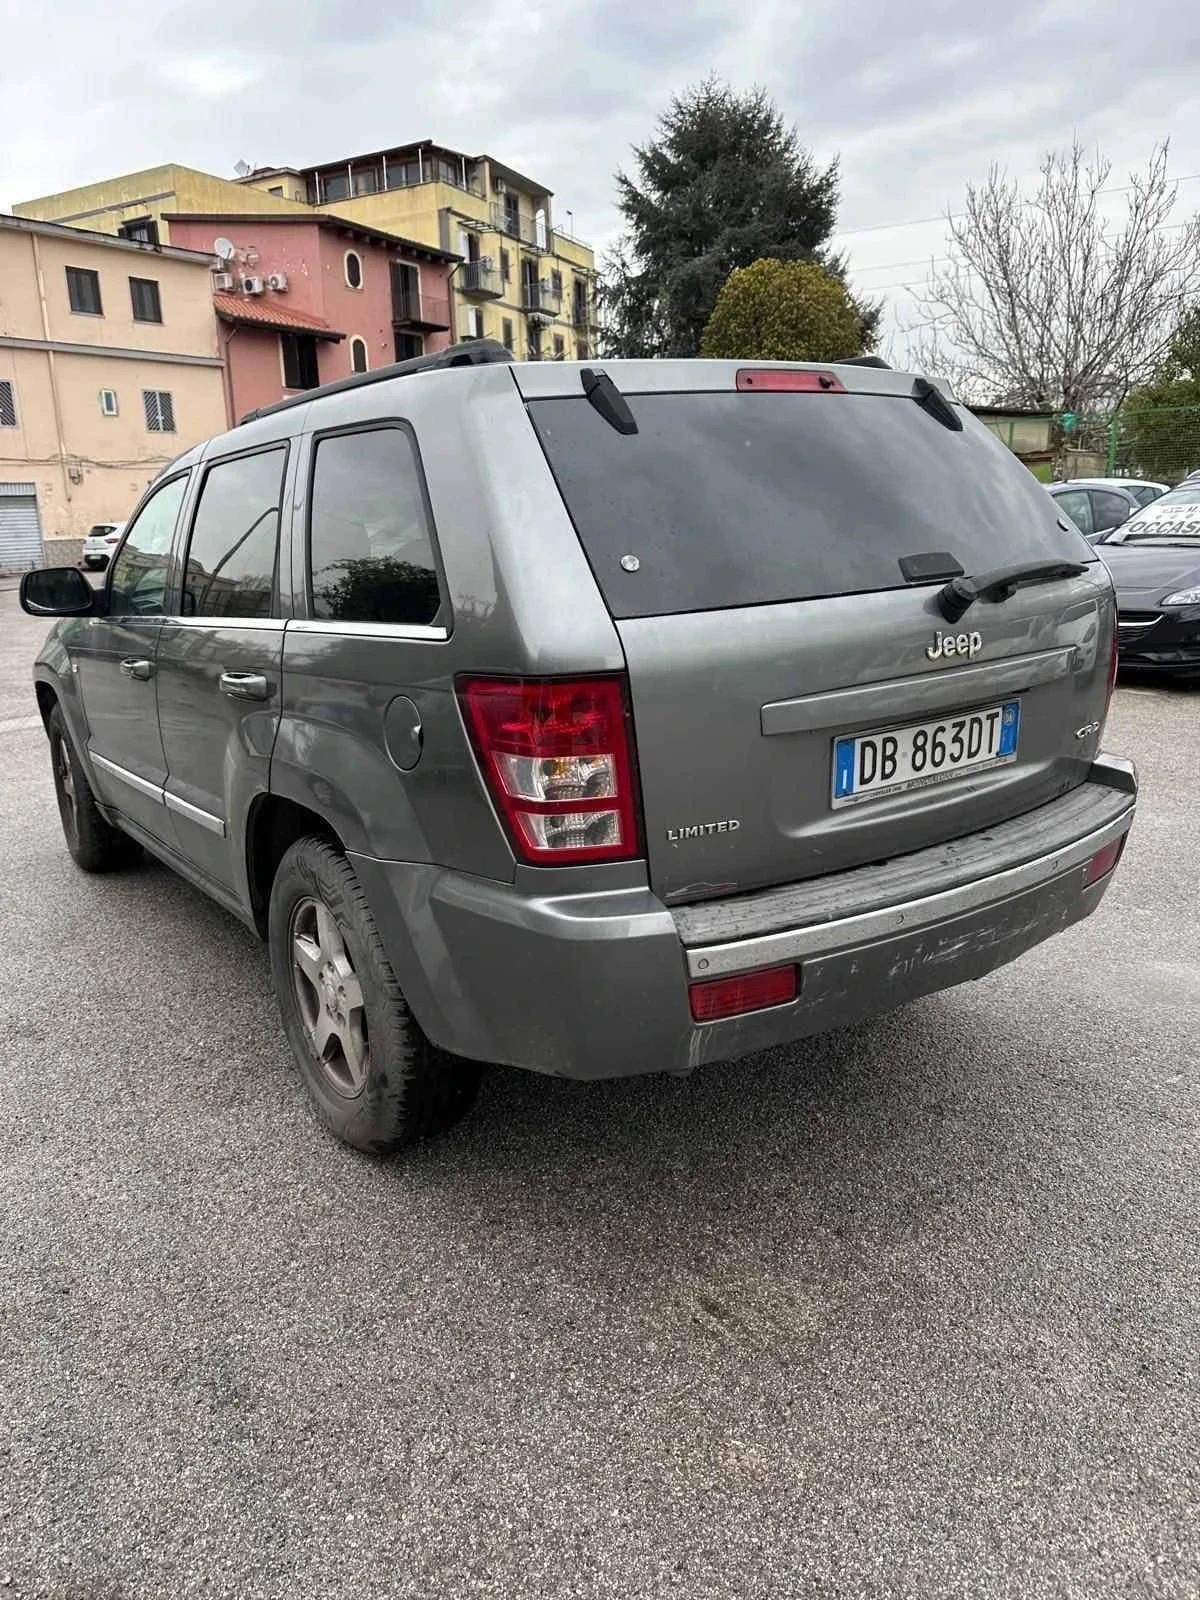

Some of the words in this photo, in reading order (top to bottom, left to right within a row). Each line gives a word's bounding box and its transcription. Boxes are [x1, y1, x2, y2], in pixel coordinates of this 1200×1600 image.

[927, 631, 983, 661] Jeep
[860, 736, 898, 786] DB
[911, 712, 999, 772] 863DT
[666, 819, 741, 841] LIMITED
